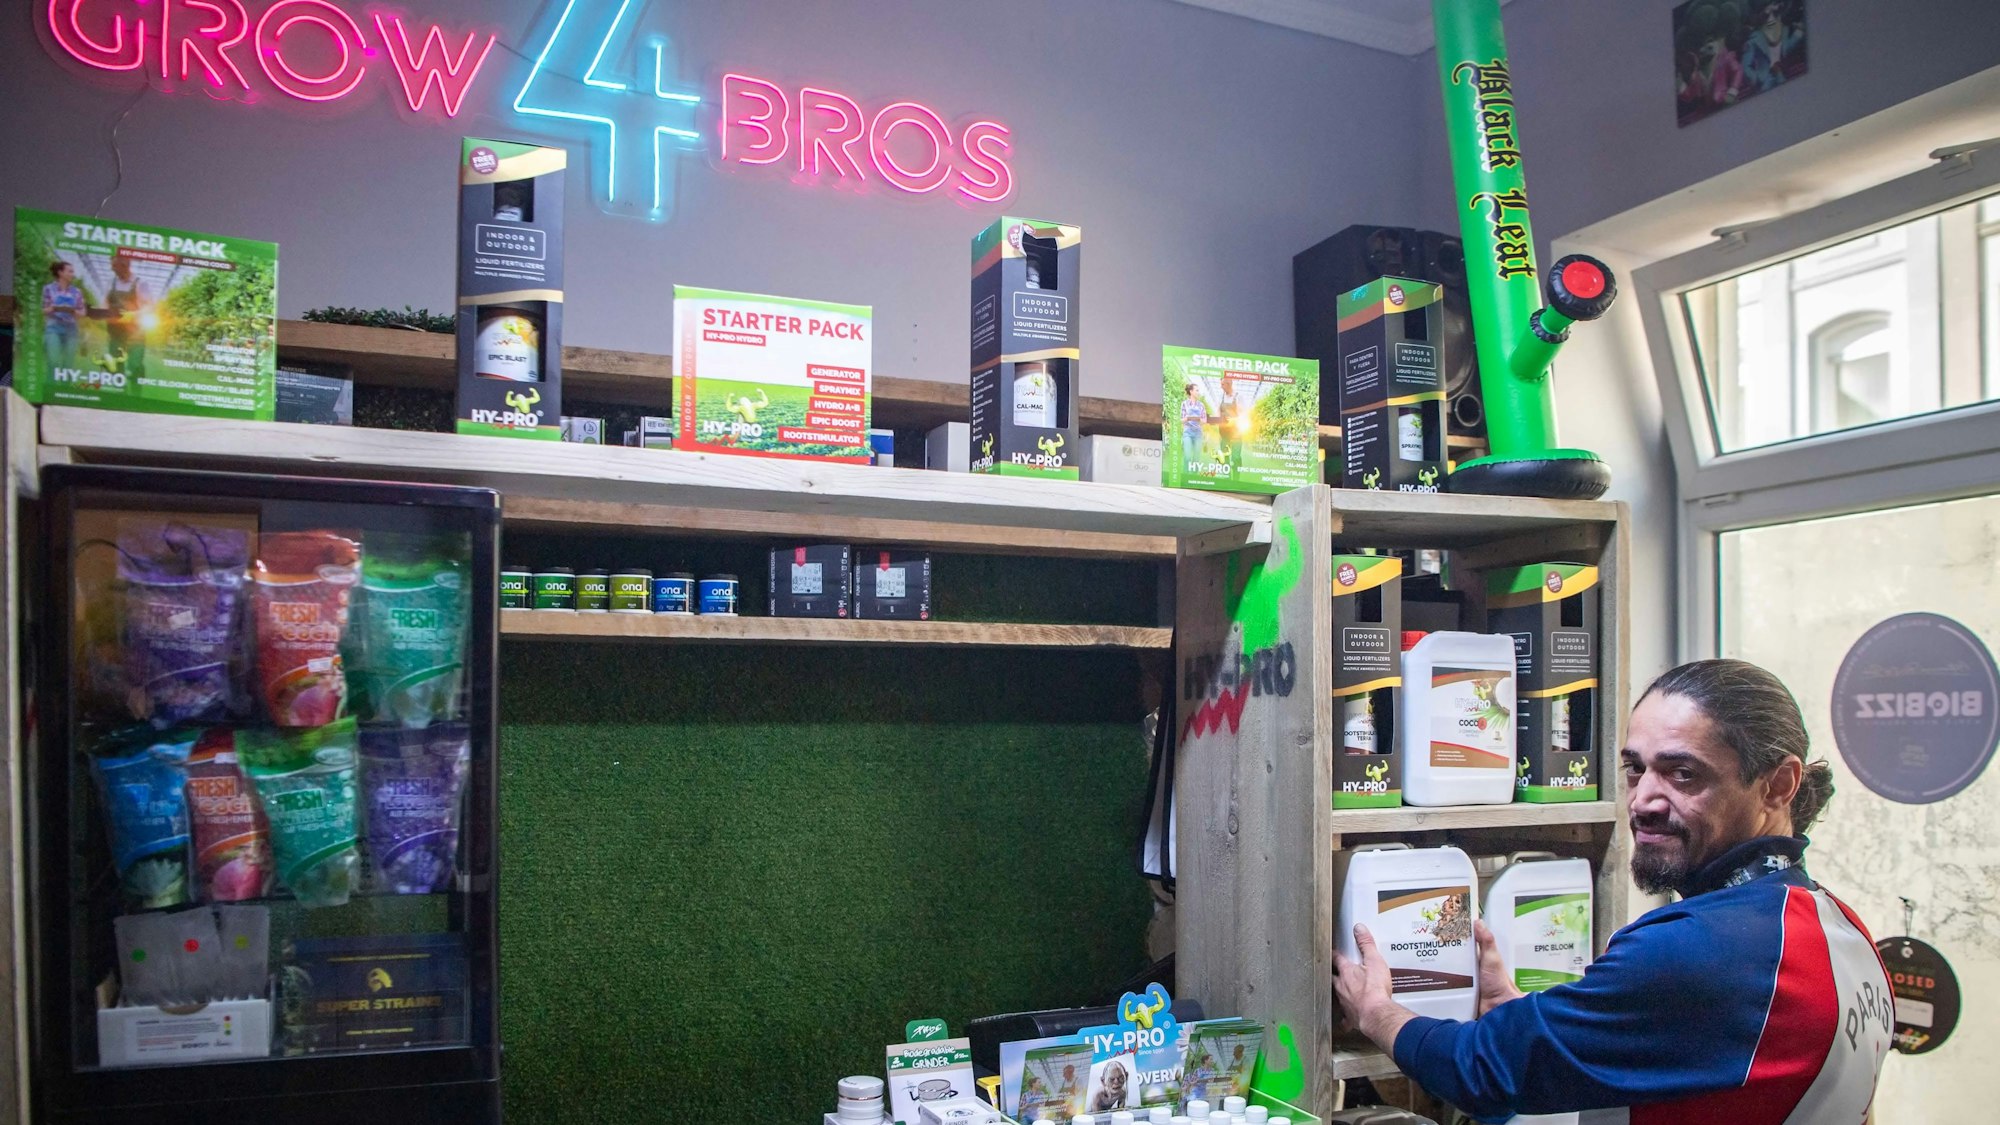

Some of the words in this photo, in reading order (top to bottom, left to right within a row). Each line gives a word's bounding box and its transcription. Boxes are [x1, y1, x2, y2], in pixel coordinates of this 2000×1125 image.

[48, 0, 497, 118] GROW
[513, 0, 702, 209] 4
[720, 72, 1013, 203] BROS
[63, 221, 165, 250] STARTER
[168, 236, 227, 259] PACK
[486, 231, 525, 241] INDOOR
[486, 241, 536, 252] OUTDOOR
[475, 257, 500, 265] LIQUID
[501, 259, 545, 270] FERTILIZERS
[1021, 298, 1052, 307] INDOOR
[1021, 306, 1060, 316] OUTDOOR
[703, 307, 802, 334] STARTER
[808, 318, 864, 341] PACK
[1034, 322, 1067, 332] FERTILIZERS
[705, 332, 736, 343] HY-PRO
[736, 334, 764, 345] HYDRO
[488, 353, 503, 361] EPIC
[504, 355, 527, 363] BLAST
[1192, 353, 1252, 371] STARTER
[1254, 360, 1290, 375] PACK
[53, 366, 127, 388] HY-PRO
[811, 367, 861, 380] GENERATOR
[819, 384, 861, 396] SPRAYMIX
[814, 400, 845, 411] HYDRO
[471, 408, 539, 427] HY-PRO
[684, 394, 692, 432] INDOOR
[811, 416, 831, 425] EPIC
[831, 418, 861, 428] BOOST
[703, 420, 763, 438] HY-PRO
[783, 430, 861, 444] ROOTSTIMULATOR
[972, 455, 994, 472] HY-PRO
[1011, 452, 1063, 468] HY-PRO
[1134, 463, 1149, 472] duo
[1188, 461, 1231, 475] HY-PRO
[1399, 483, 1438, 494] HY-PRO
[1339, 569, 1354, 577] FREE
[500, 582, 523, 590] ona
[545, 583, 568, 591] ona
[584, 583, 606, 592] ona
[661, 587, 681, 595] ona
[711, 588, 732, 596] ona
[269, 602, 322, 625] FRESH
[388, 608, 439, 630] FRESH
[1184, 641, 1297, 700] HY-PRO
[386, 777, 431, 796] FRESH
[1342, 781, 1388, 793] HY-PRO
[1550, 776, 1587, 788] HY-PRO
[273, 788, 324, 811] FRESH
[1390, 939, 1462, 952] ROOTSTIMULATOR
[1534, 944, 1550, 952] EPIC
[1550, 943, 1574, 951] BLOOM
[1416, 949, 1439, 958] COCO
[1894, 972, 1936, 989] OSED
[316, 999, 369, 1015] SUPER
[1844, 981, 1892, 1053] PARIS
[1084, 1027, 1165, 1054] HY-PRO
[903, 1045, 957, 1058] Biodegradable
[892, 1056, 901, 1065] 2
[912, 1056, 950, 1069] GRINDER
[1136, 1068, 1178, 1085] OVERY
